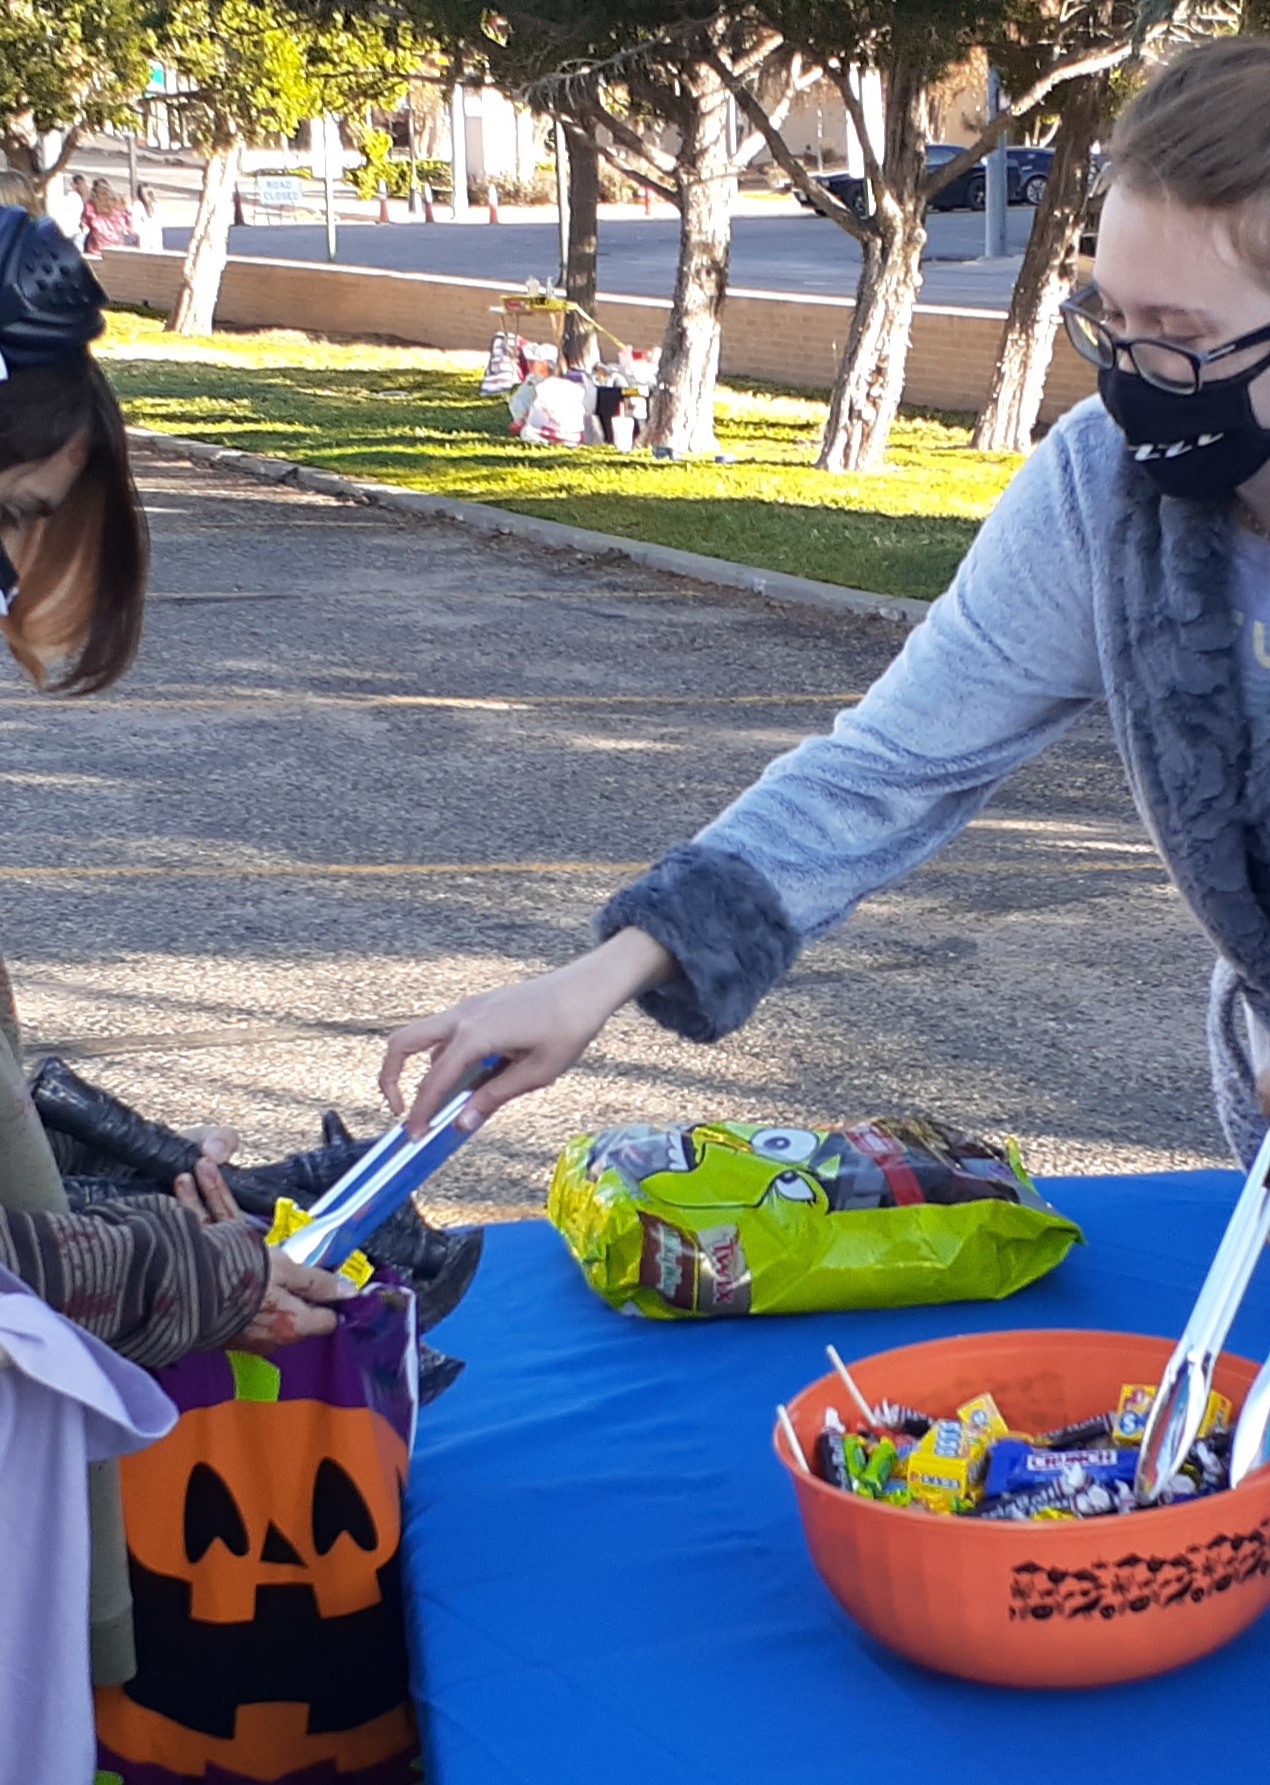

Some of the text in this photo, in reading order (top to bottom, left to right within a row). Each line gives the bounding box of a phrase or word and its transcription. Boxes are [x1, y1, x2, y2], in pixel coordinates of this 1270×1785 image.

[265, 180, 292, 190] ROAD
[263, 191, 299, 201] CLOSED
[1030, 1450, 1115, 1467] CRUNCH
